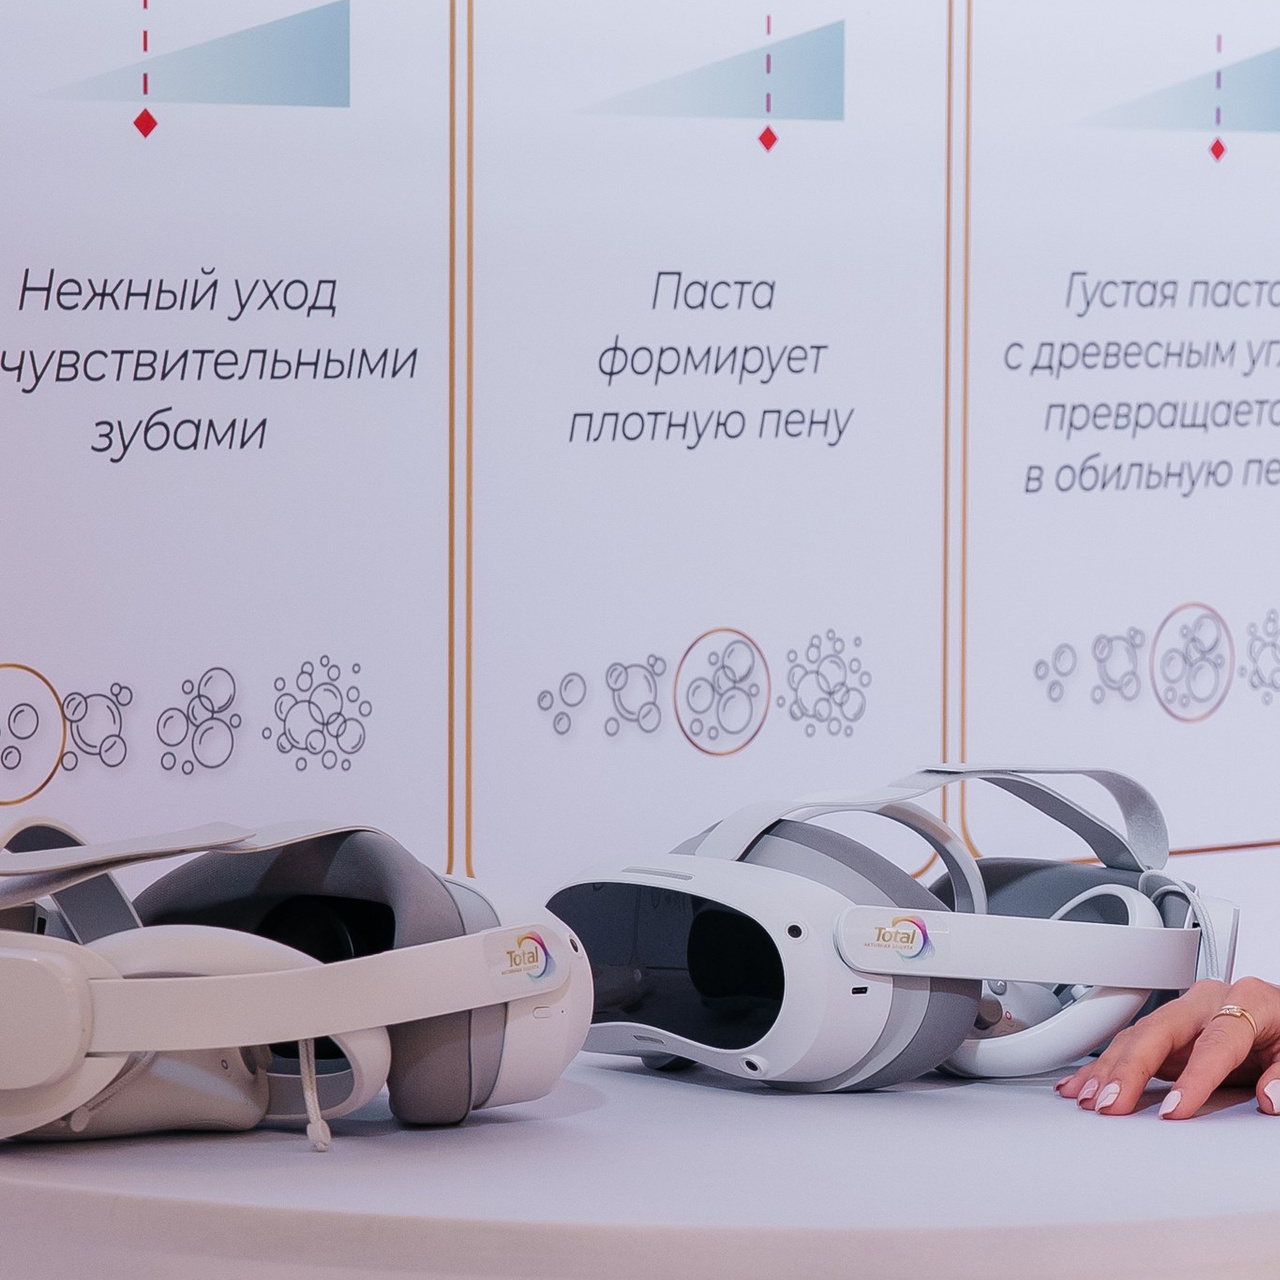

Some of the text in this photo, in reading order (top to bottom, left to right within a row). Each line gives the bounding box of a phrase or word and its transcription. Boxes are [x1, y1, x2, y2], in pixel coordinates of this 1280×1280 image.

[18, 267, 337, 323] Нежный уход
[651, 270, 776, 311] Паста
[1065, 270, 1179, 319] Густая
[0, 347, 418, 395] чувствительными
[597, 334, 829, 387] формирует
[1003, 341, 1025, 372] с
[1029, 340, 1237, 380] древесным
[90, 406, 268, 464] зубами
[568, 408, 855, 451] плотную пену
[1024, 464, 1045, 495] в
[1054, 451, 1234, 499] обильную
[506, 946, 540, 968] Total
[874, 926, 917, 945] Total
